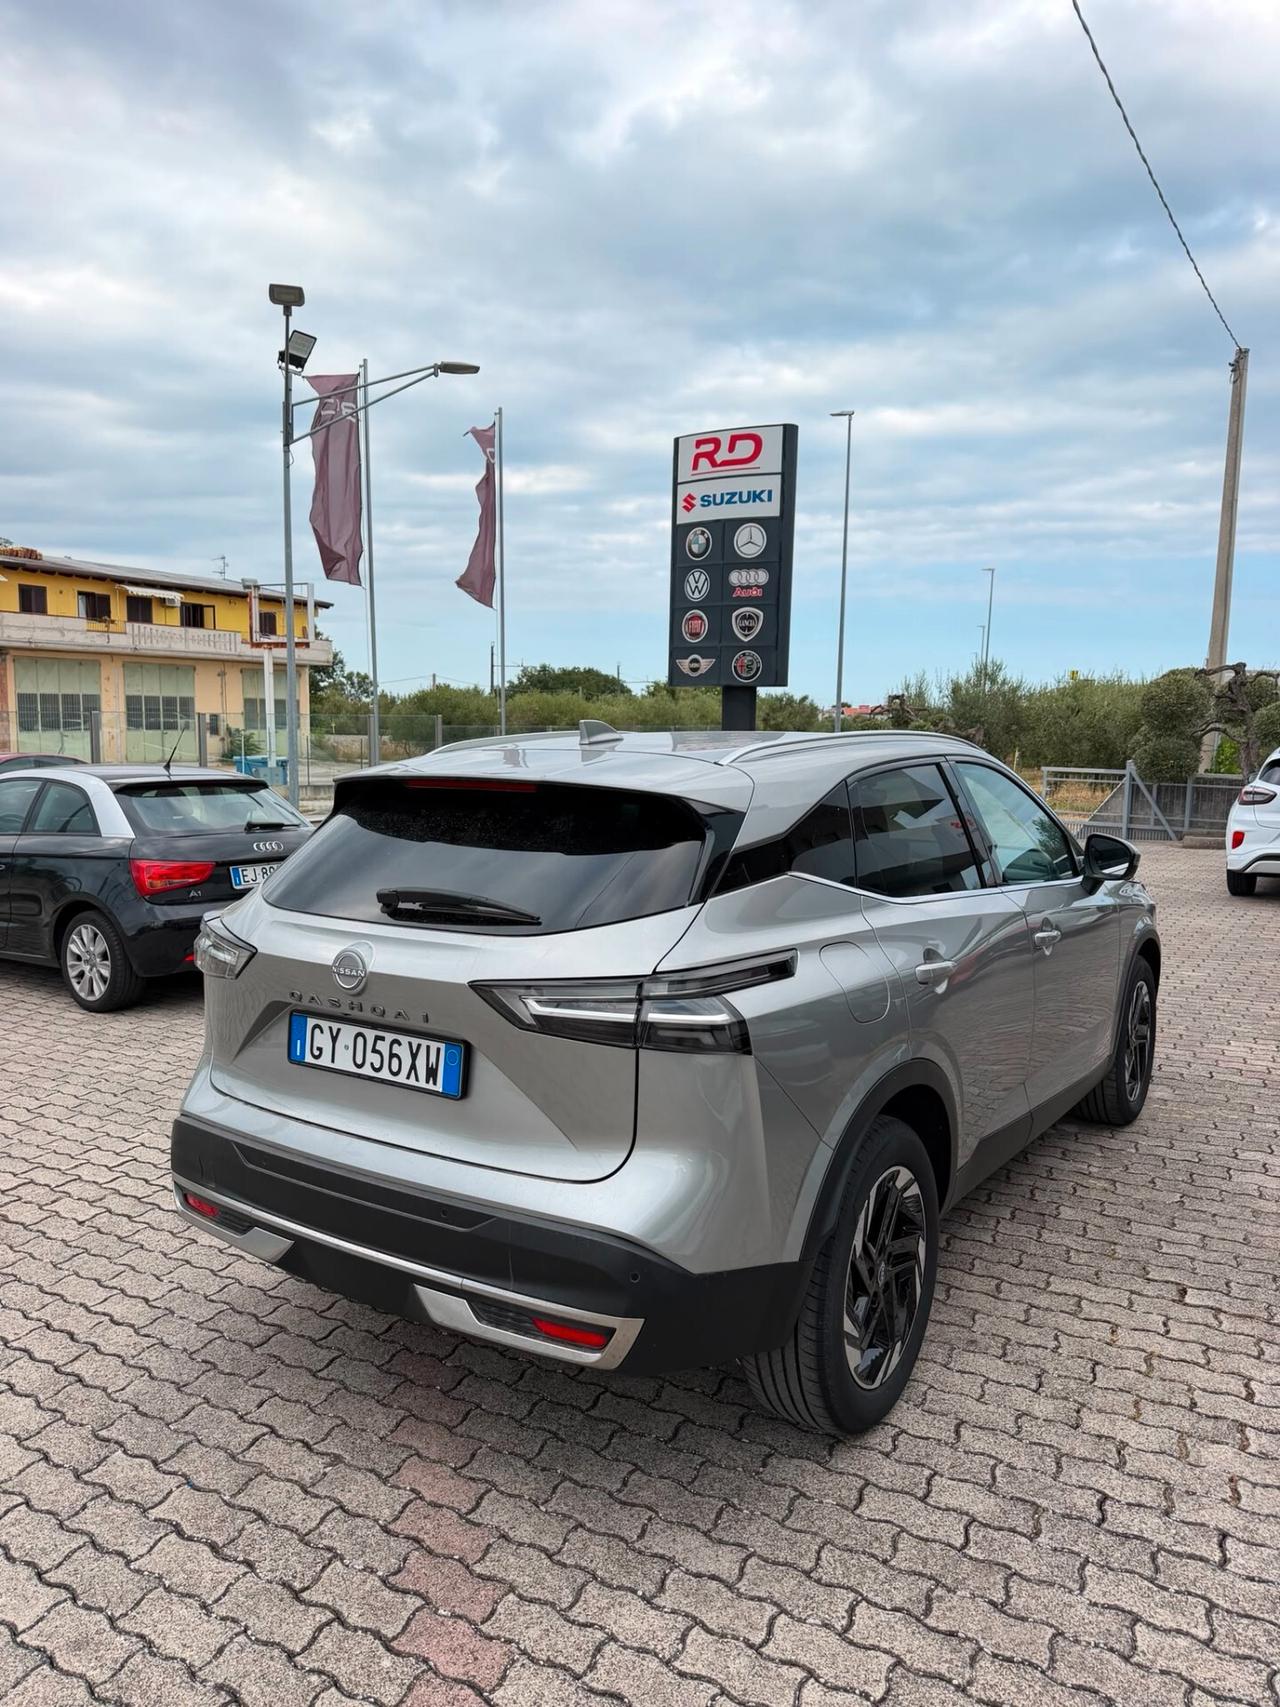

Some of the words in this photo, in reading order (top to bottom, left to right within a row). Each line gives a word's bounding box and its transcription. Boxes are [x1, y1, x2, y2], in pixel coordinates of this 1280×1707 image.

[692, 433, 763, 471] RD
[700, 489, 773, 507] SUZUKI
[733, 587, 763, 598] Audi
[189, 889, 202, 897] A1
[332, 965, 365, 977] NISSAN
[289, 990, 429, 1024] QASHQAI
